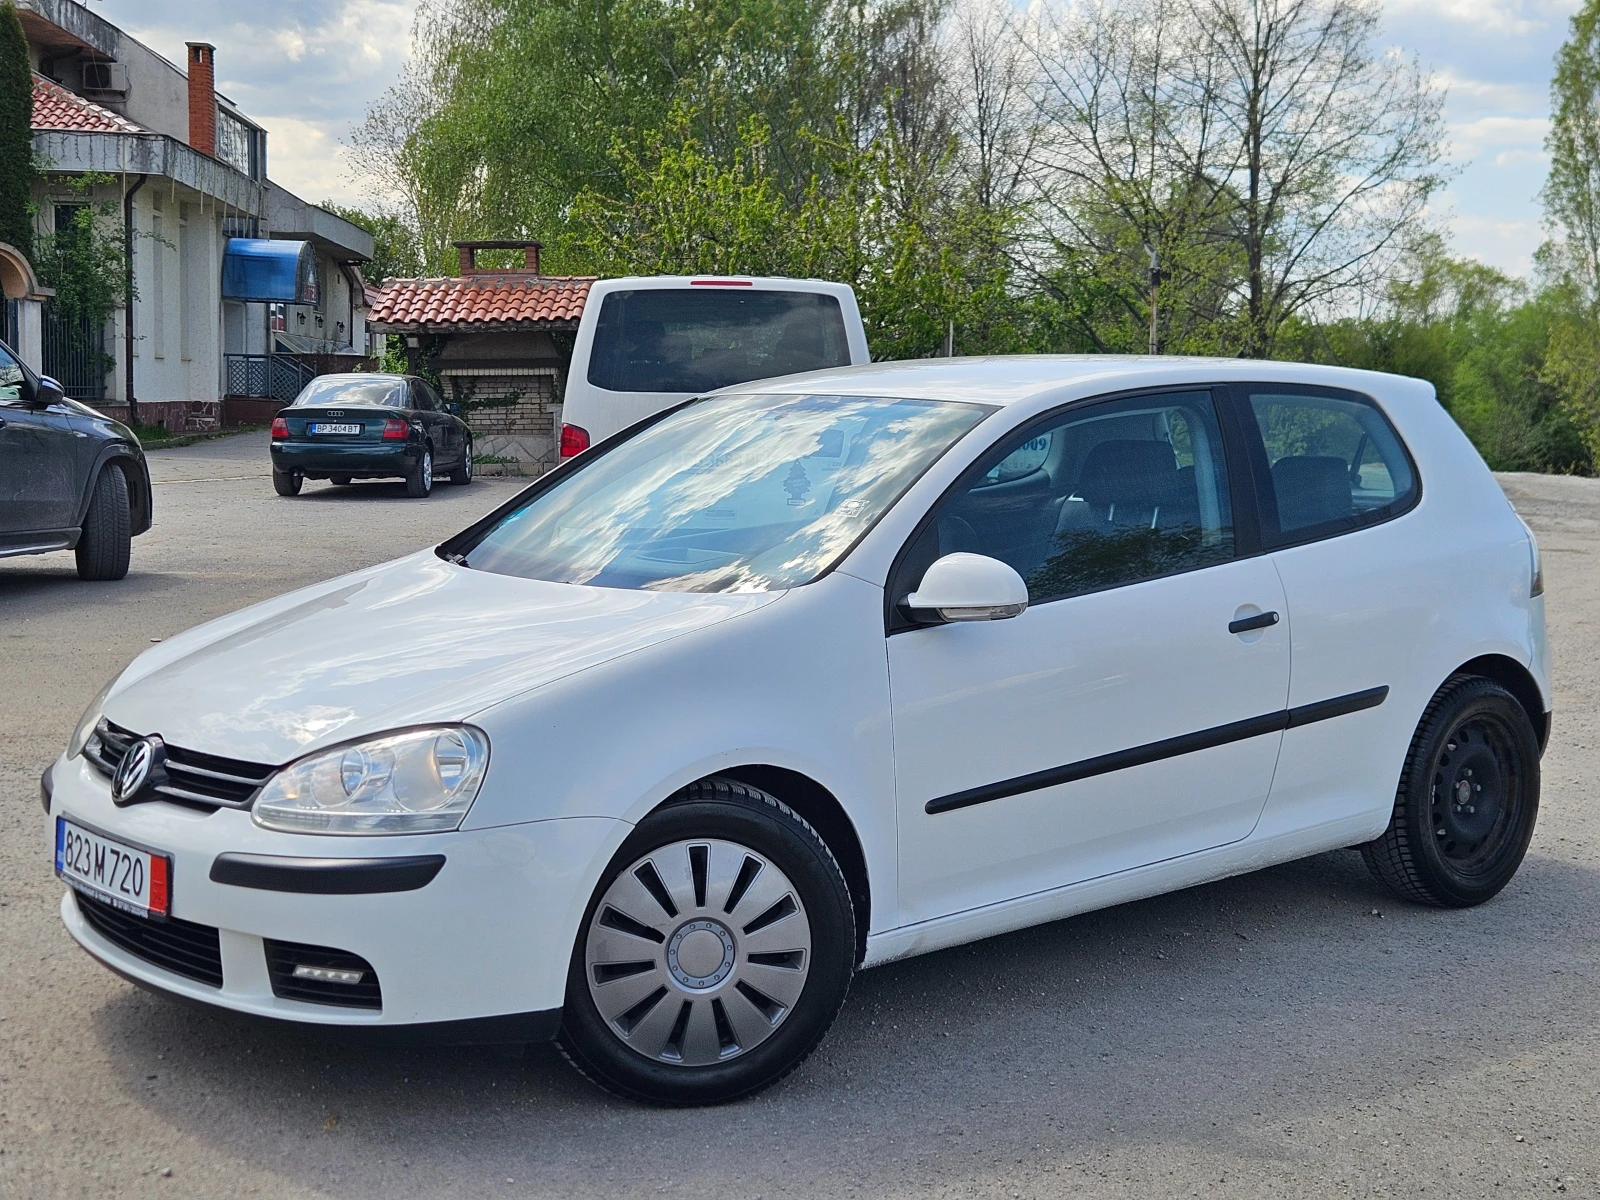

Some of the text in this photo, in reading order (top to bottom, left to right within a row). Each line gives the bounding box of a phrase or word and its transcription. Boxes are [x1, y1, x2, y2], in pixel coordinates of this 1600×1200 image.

[111, 740, 151, 802] VW
[65, 829, 91, 876] 823
[93, 841, 106, 885] M
[108, 849, 144, 897] 720
